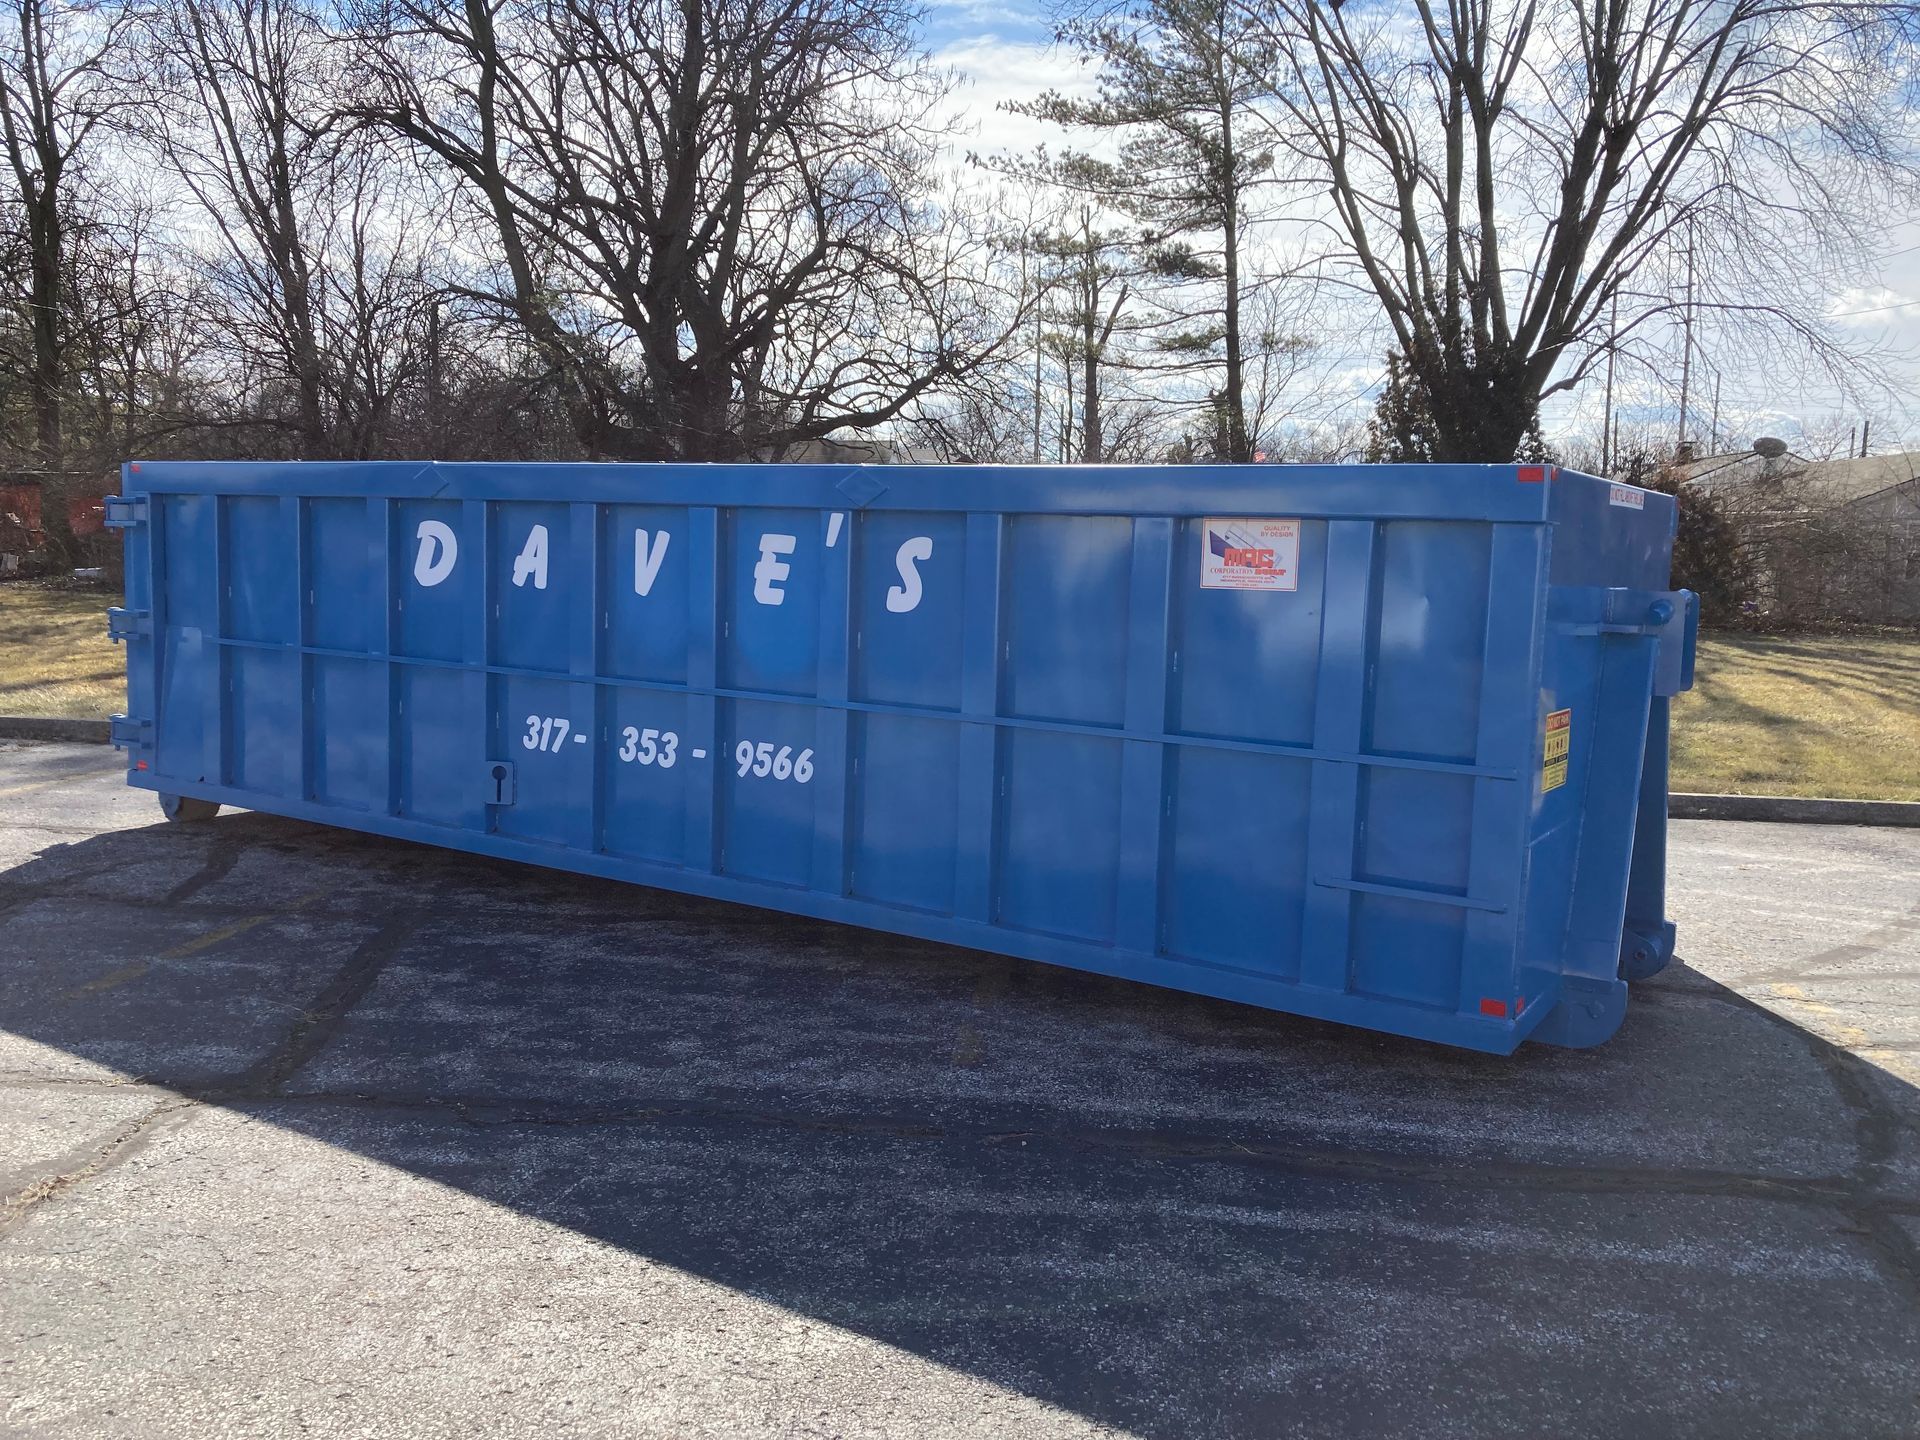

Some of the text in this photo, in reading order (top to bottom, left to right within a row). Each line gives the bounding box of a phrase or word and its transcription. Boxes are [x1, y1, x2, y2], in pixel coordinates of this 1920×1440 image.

[415, 514, 933, 612] DAVE'S
[1210, 567, 1253, 575] CORPORATION
[1224, 548, 1274, 569] MAC
[737, 740, 814, 782] 9566
